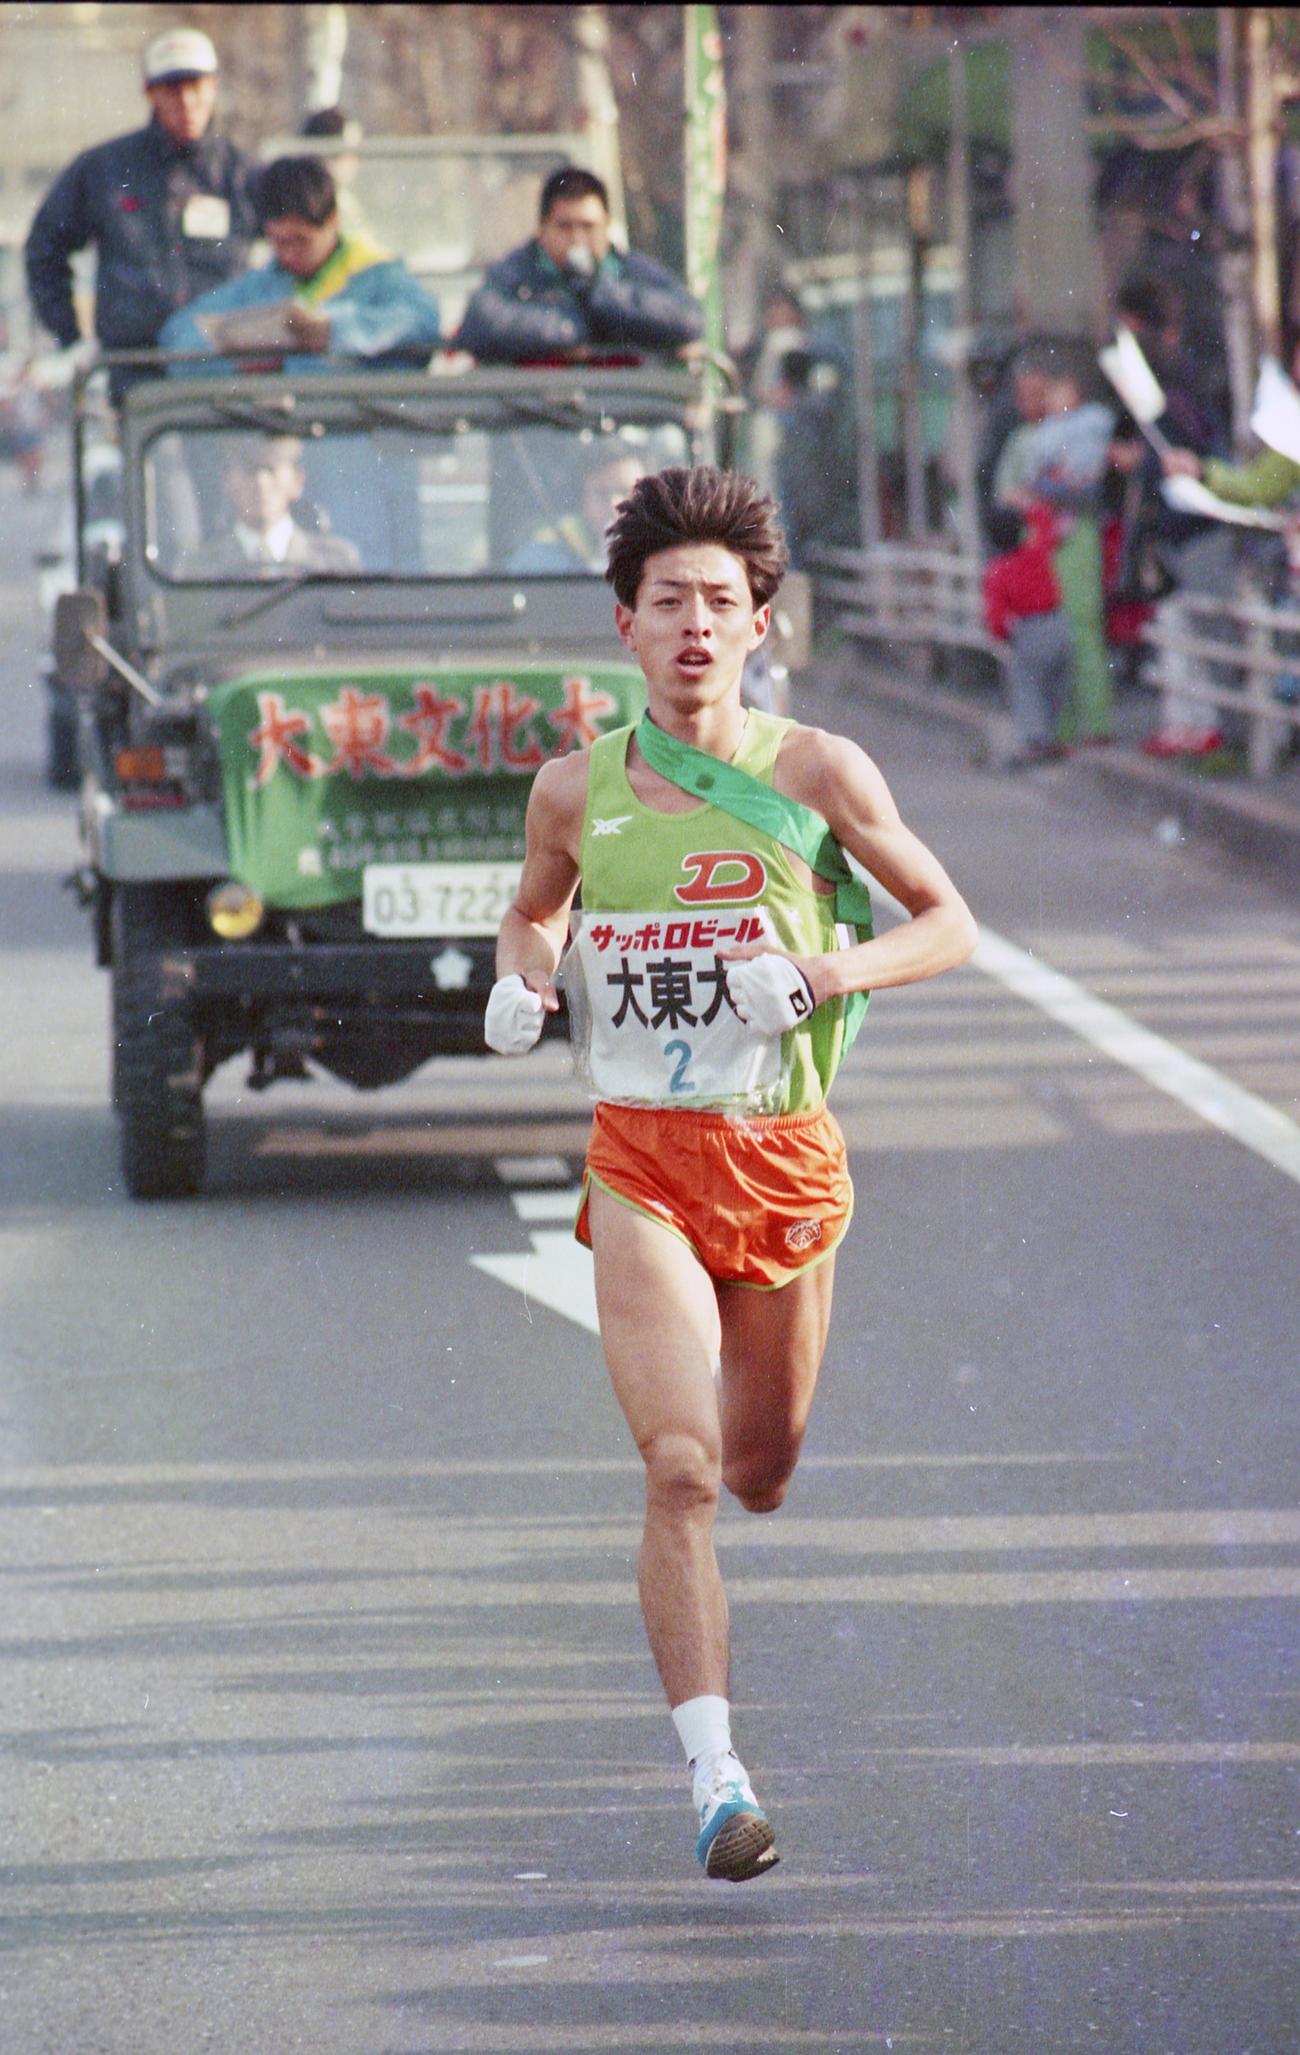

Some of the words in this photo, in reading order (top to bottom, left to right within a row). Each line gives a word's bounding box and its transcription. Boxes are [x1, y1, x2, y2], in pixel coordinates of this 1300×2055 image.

[249, 676, 617, 790] 大東文化大
[673, 849, 768, 905] D
[589, 917, 766, 953] サッポロビール
[606, 954, 748, 1031] 大東大
[663, 1039, 696, 1094] 2
